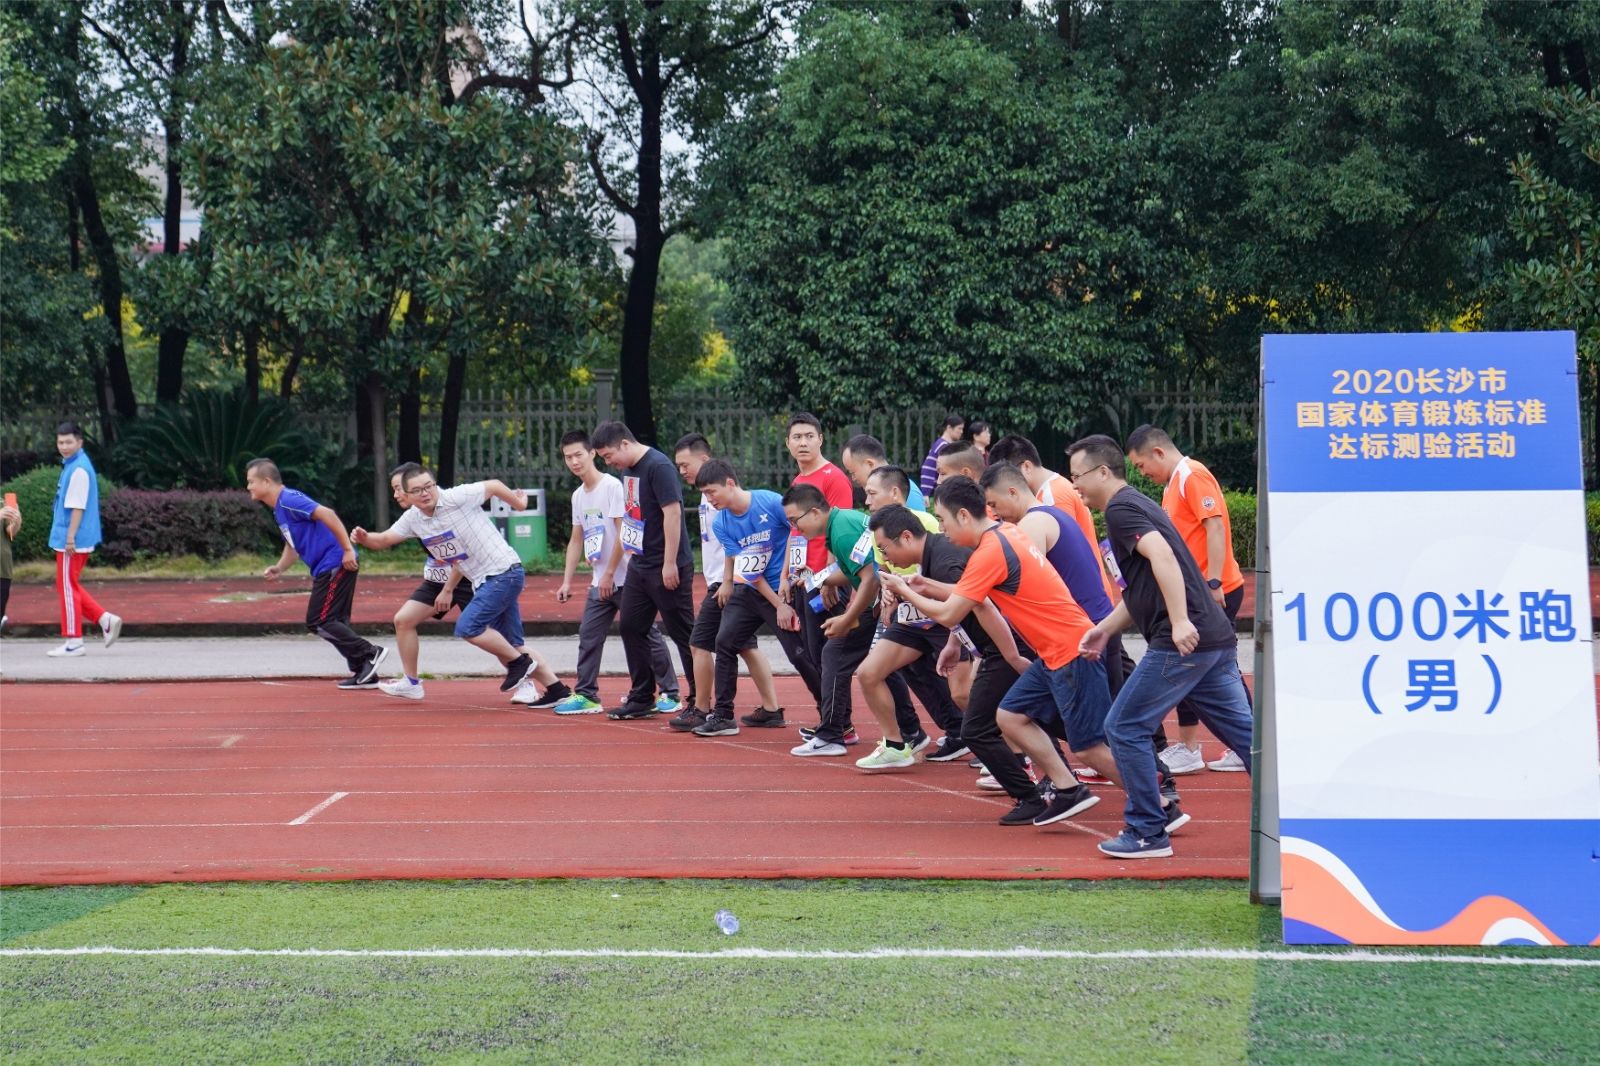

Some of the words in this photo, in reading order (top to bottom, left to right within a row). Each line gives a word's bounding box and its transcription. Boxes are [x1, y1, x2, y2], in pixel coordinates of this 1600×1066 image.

[1331, 367, 1507, 395] 2020长沙市
[1296, 399, 1547, 428] 国家体育锻炼标准
[1329, 431, 1516, 459] 达标测验活动
[742, 554, 767, 573] 223
[1284, 588, 1577, 644] 1000米跑
[1362, 654, 1502, 714] （男）
